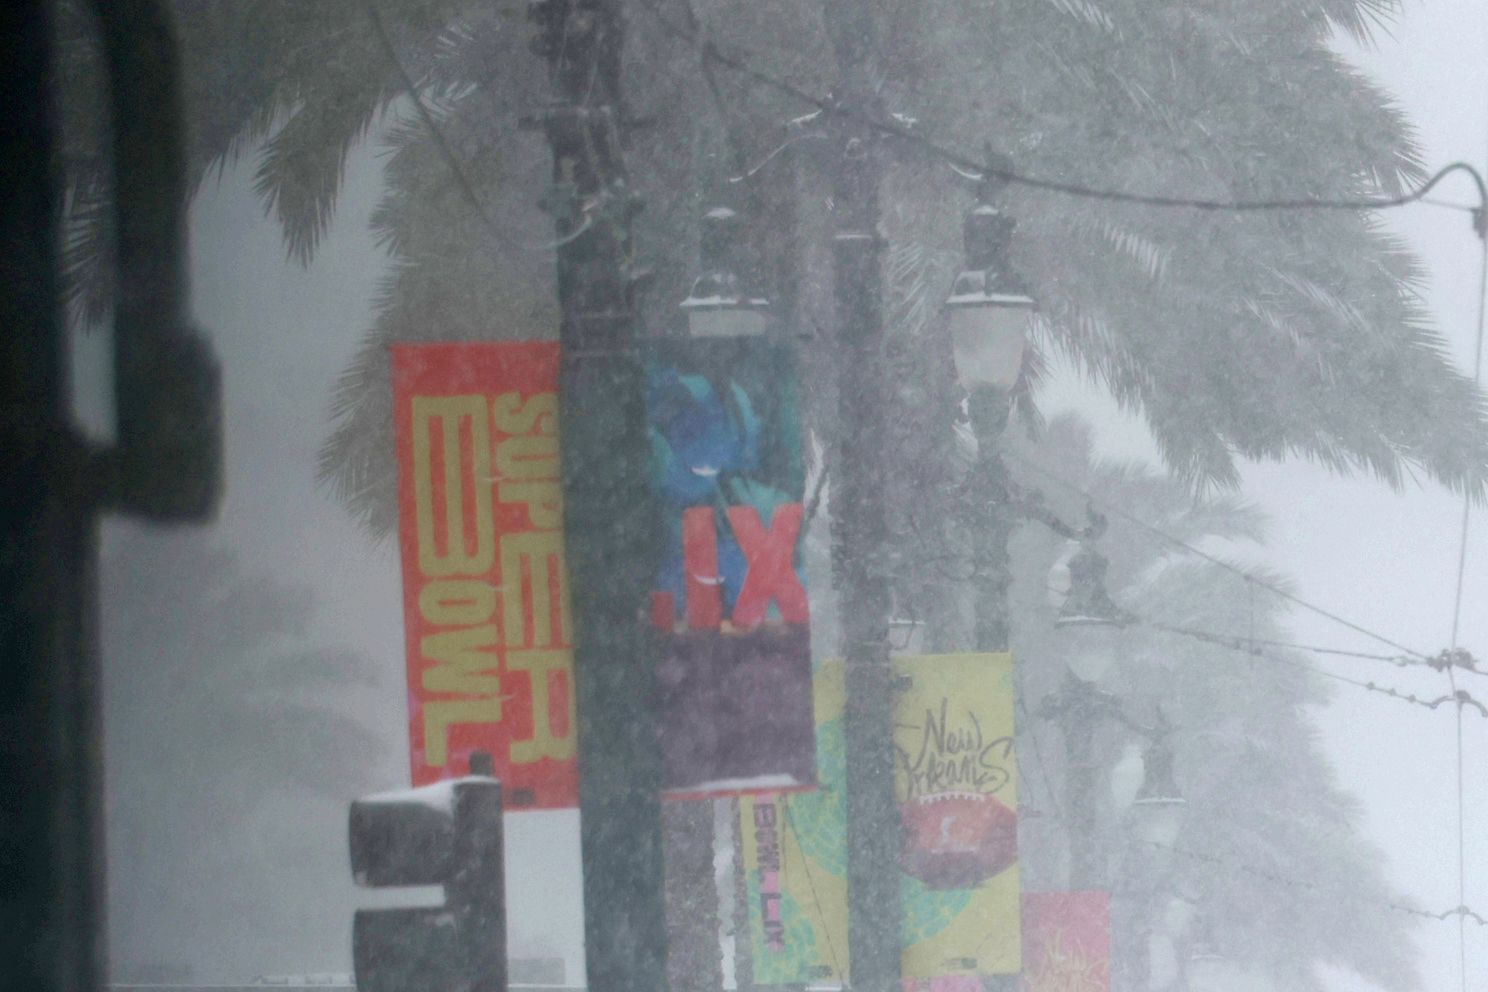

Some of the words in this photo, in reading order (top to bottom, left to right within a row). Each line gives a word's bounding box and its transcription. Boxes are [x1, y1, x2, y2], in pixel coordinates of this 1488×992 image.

[411, 394, 503, 767] BOWL
[494, 391, 579, 764] SUPER
[650, 503, 811, 632] IX
[914, 697, 983, 762] New
[761, 893, 785, 945] LIX
